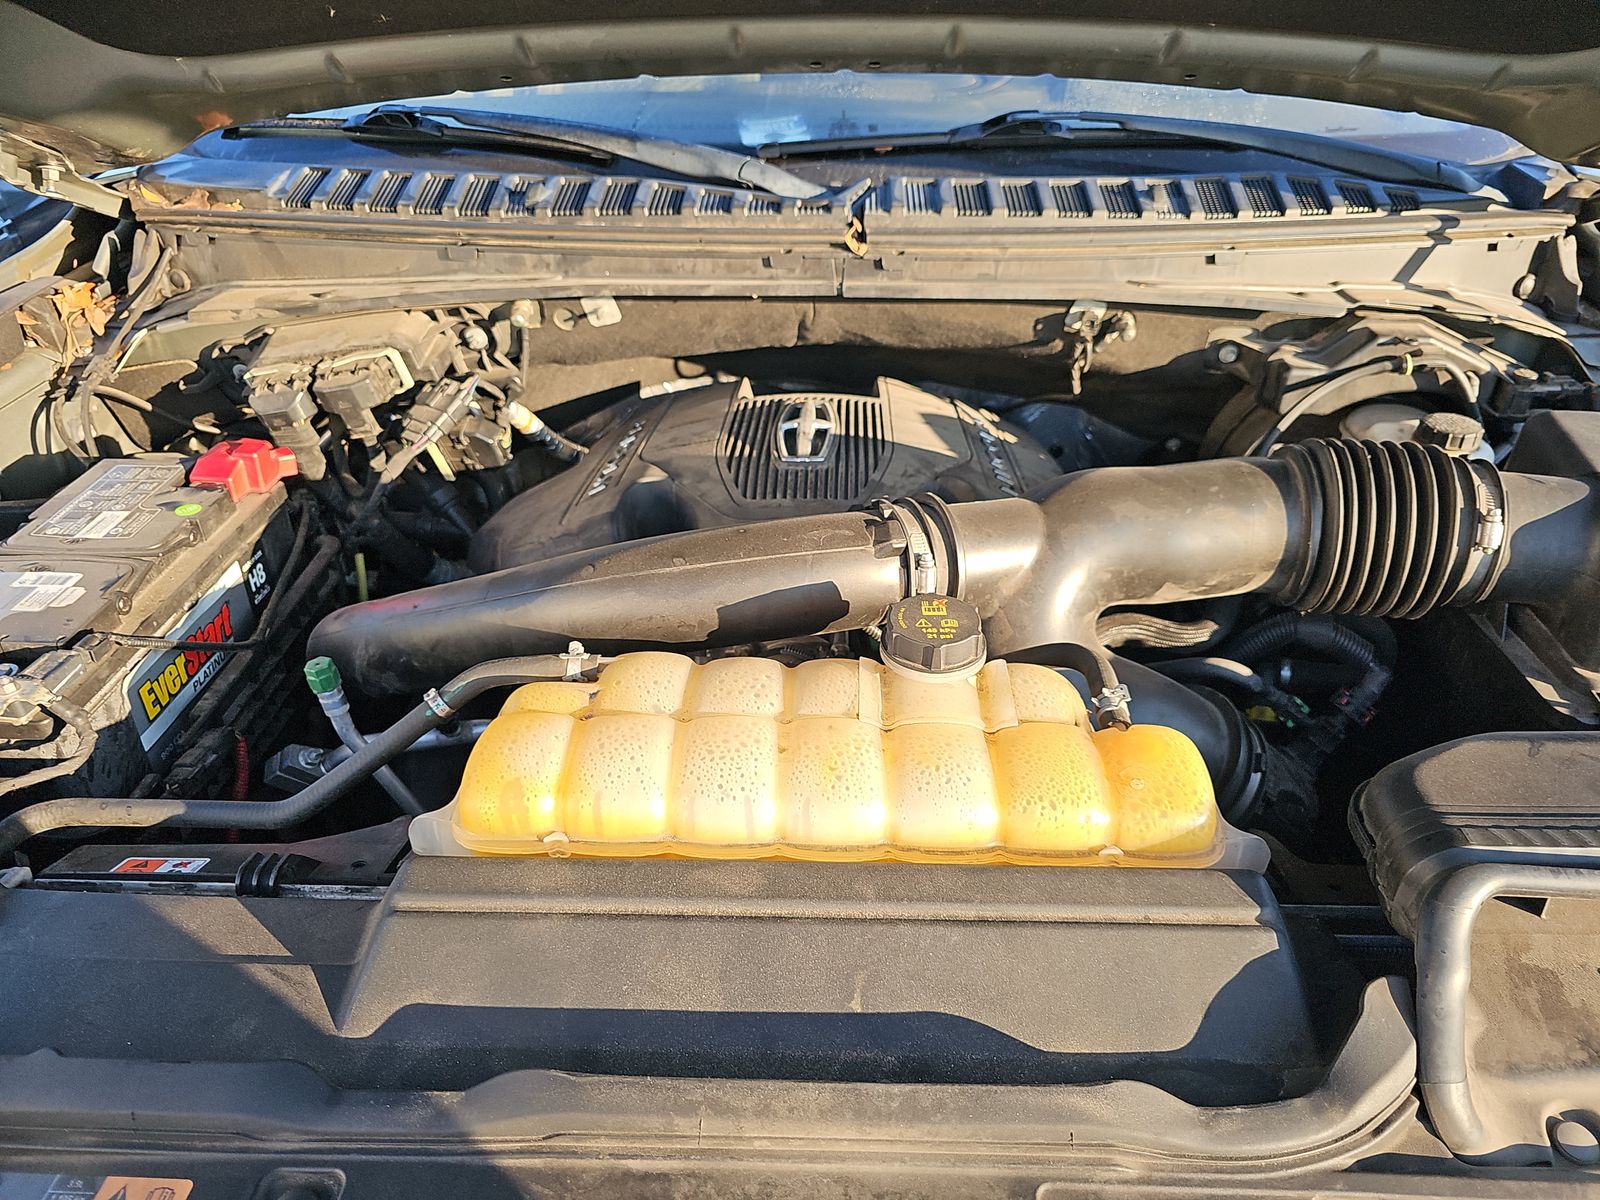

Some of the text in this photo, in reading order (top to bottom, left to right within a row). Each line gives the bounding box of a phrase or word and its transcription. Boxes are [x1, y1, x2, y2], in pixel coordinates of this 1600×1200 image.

[248, 562, 267, 593] H8
[138, 601, 233, 722] EverStart
[192, 650, 228, 693] PLATINU
